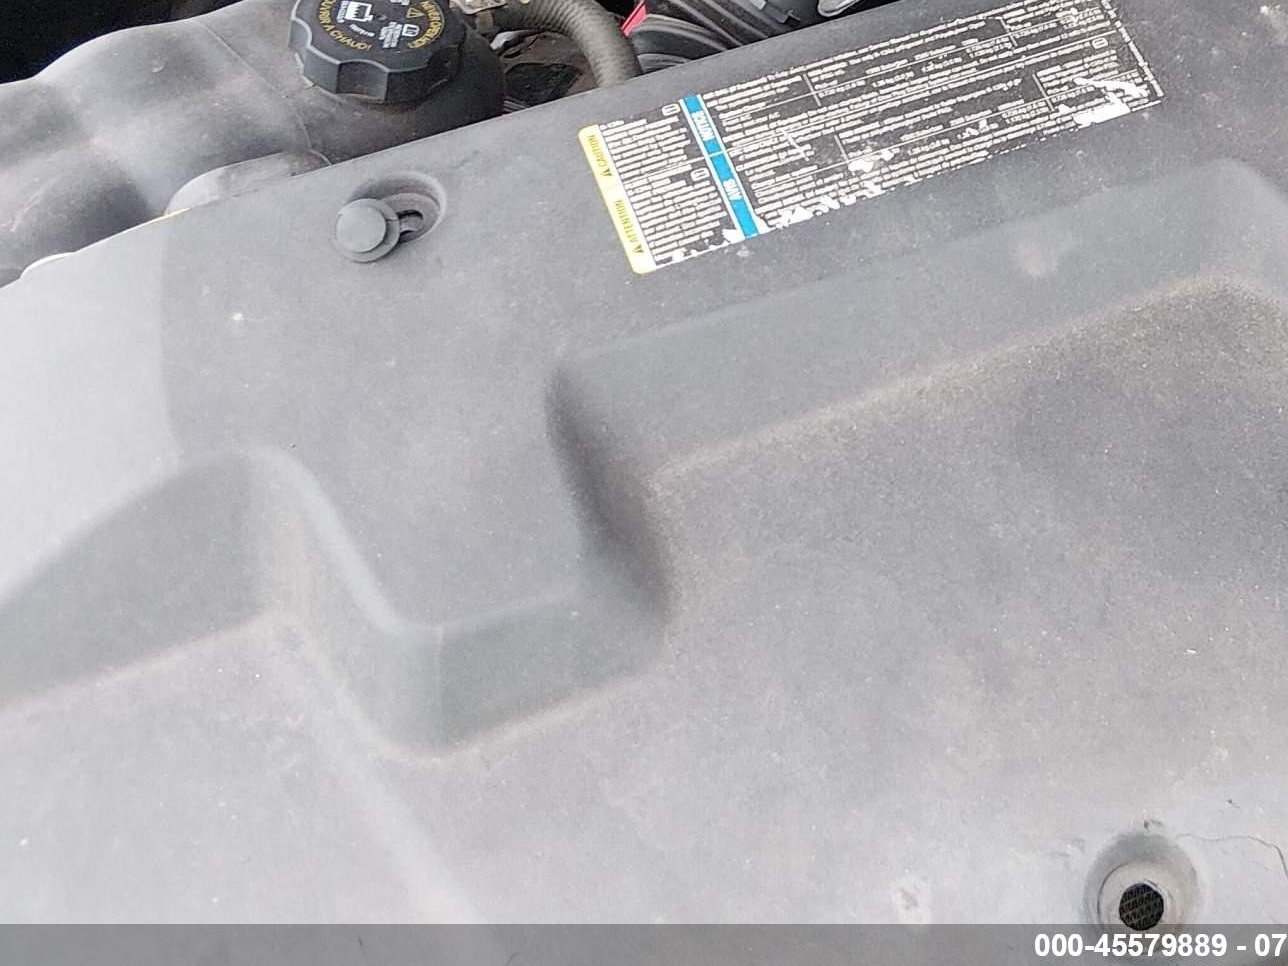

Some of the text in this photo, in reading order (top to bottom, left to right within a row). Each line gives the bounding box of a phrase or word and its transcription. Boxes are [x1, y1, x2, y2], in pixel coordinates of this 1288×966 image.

[691, 111, 715, 141] NOTICE
[587, 135, 608, 169] CAUTION
[722, 178, 742, 201] AVIS
[614, 200, 639, 243] ATTENTION
